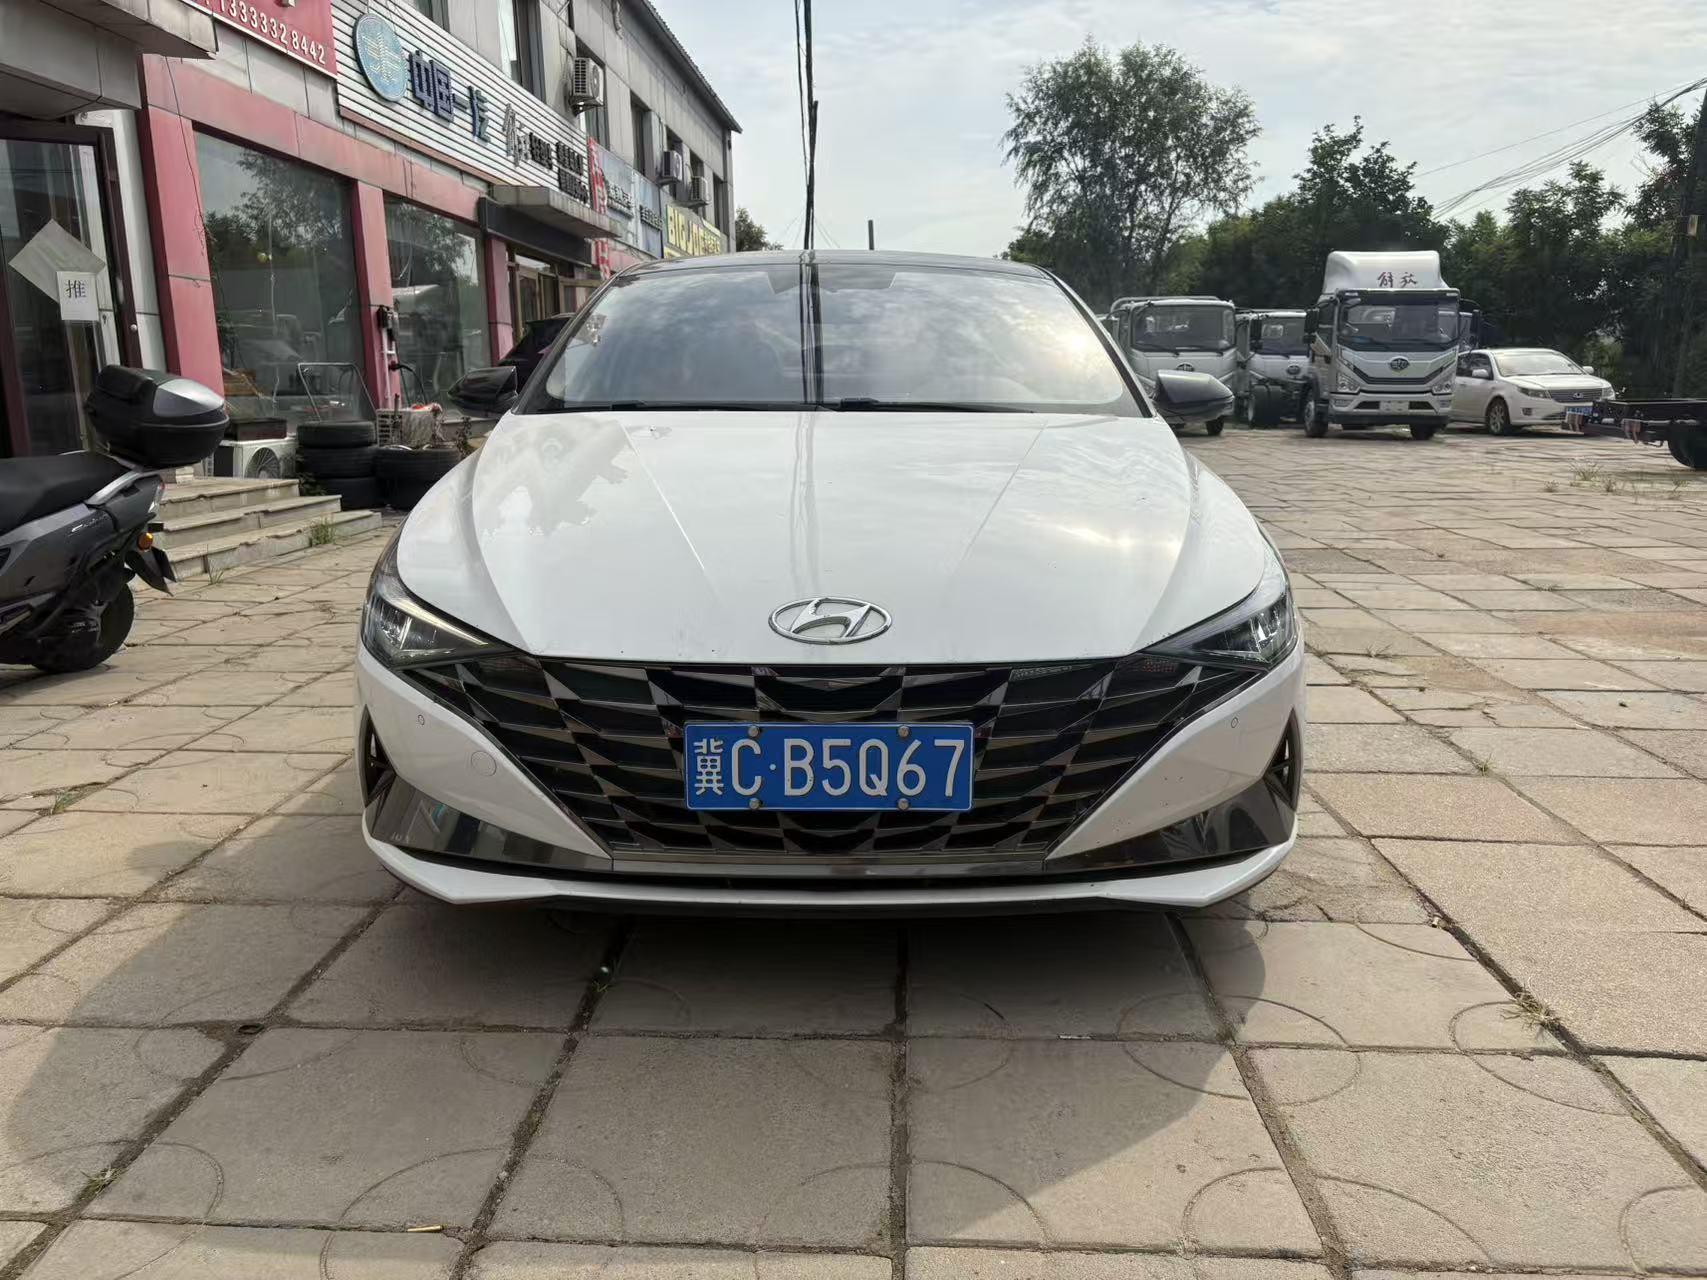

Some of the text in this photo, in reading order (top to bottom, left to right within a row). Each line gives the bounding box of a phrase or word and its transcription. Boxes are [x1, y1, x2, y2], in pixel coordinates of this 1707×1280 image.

[408, 49, 492, 144] 中国一汽
[65, 279, 88, 299] 推
[1377, 271, 1417, 288] 解放
[694, 738, 966, 797] 冀C·B5Q67
